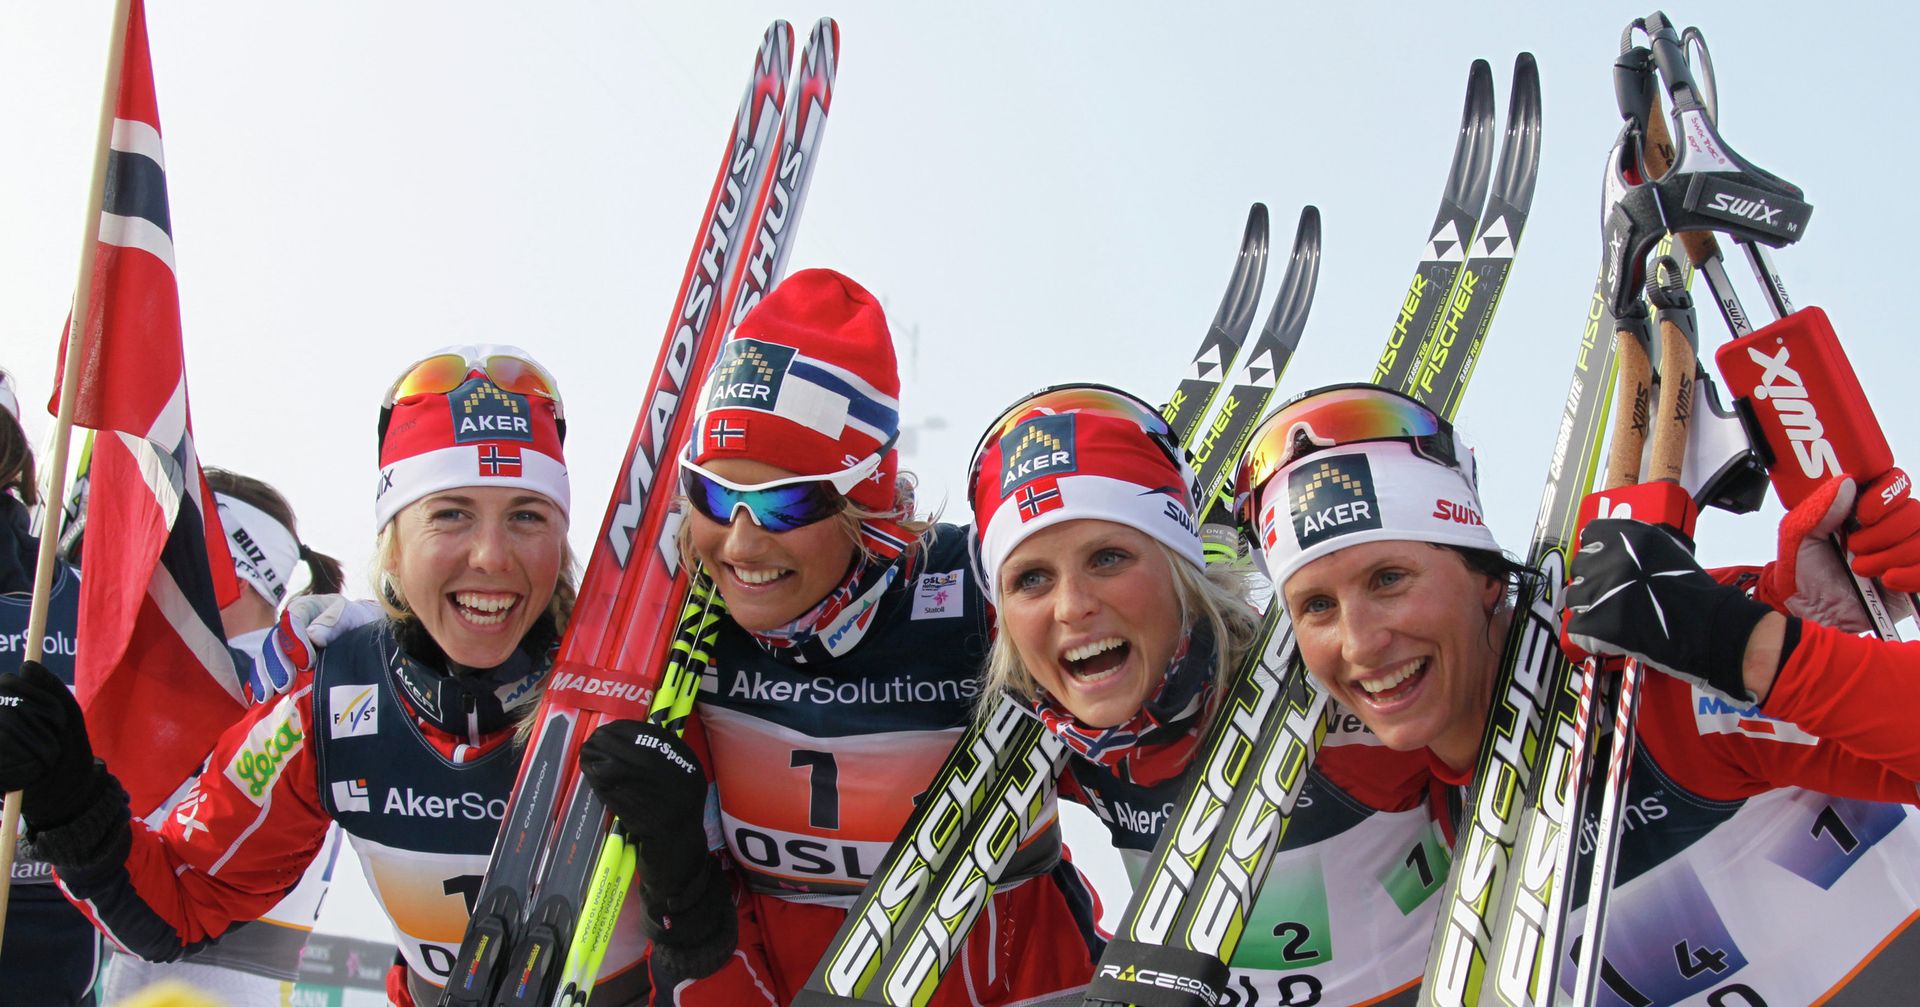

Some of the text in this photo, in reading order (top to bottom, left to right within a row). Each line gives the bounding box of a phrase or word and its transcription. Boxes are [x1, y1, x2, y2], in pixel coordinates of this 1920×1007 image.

[1787, 222, 1798, 233] M
[1370, 273, 1428, 386] FISCHER
[1420, 269, 1480, 394] FISCHER
[608, 138, 756, 571] MADSHUS
[713, 382, 771, 401] AKER
[459, 415, 529, 434] AKER
[1551, 375, 1585, 480] CARBON LITE
[1003, 450, 1070, 489] AKER
[1303, 499, 1372, 538] AKER
[232, 527, 266, 567] BLIZ
[396, 667, 436, 712] AKER
[549, 671, 655, 705] MADSHUS
[729, 669, 978, 705] AkerSolutions
[524, 761, 548, 829] CHAMPION
[789, 749, 839, 830] 1
[1811, 805, 1860, 855] 1
[1405, 842, 1434, 888] 1
[1273, 921, 1319, 962] 2
[1674, 939, 1728, 980] 4
